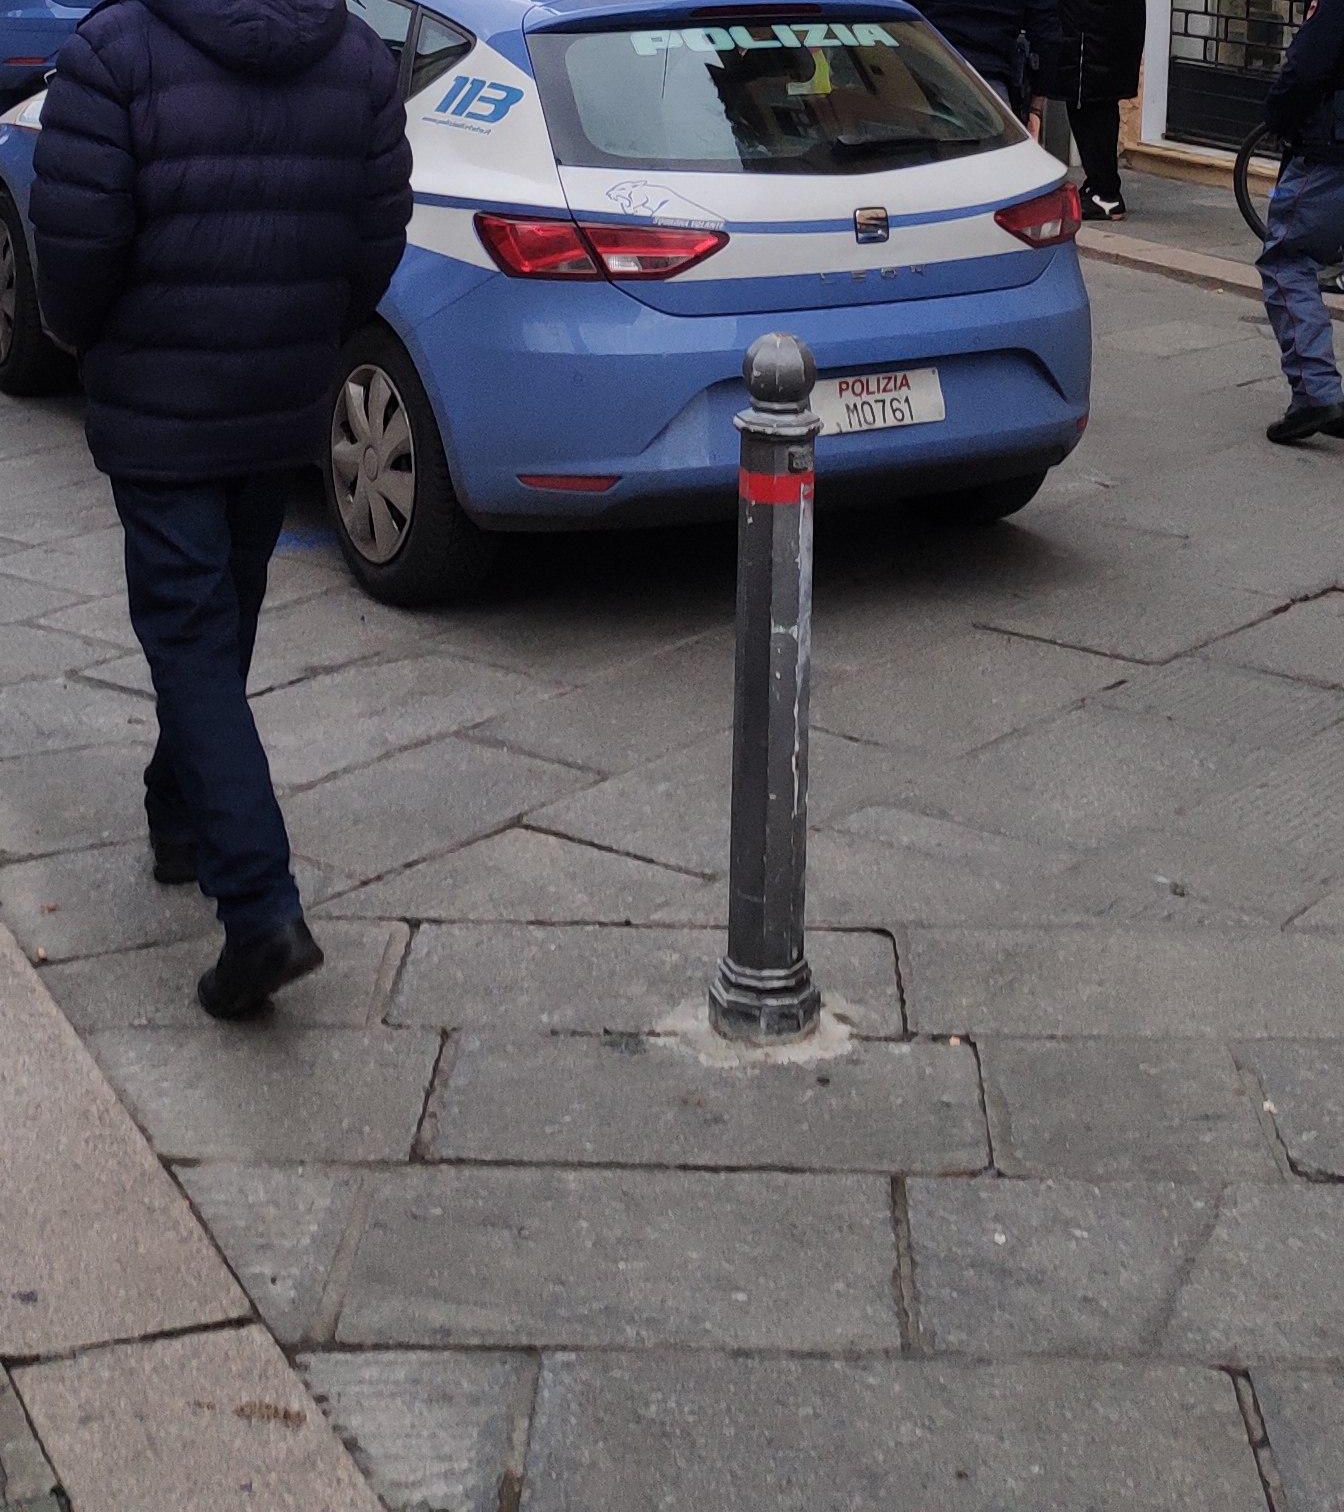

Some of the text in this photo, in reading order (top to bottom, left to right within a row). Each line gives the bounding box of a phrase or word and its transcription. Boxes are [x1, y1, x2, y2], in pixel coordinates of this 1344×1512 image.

[630, 23, 900, 56] POLIZIA
[434, 75, 524, 123] 113
[838, 373, 911, 398] POLIZIA
